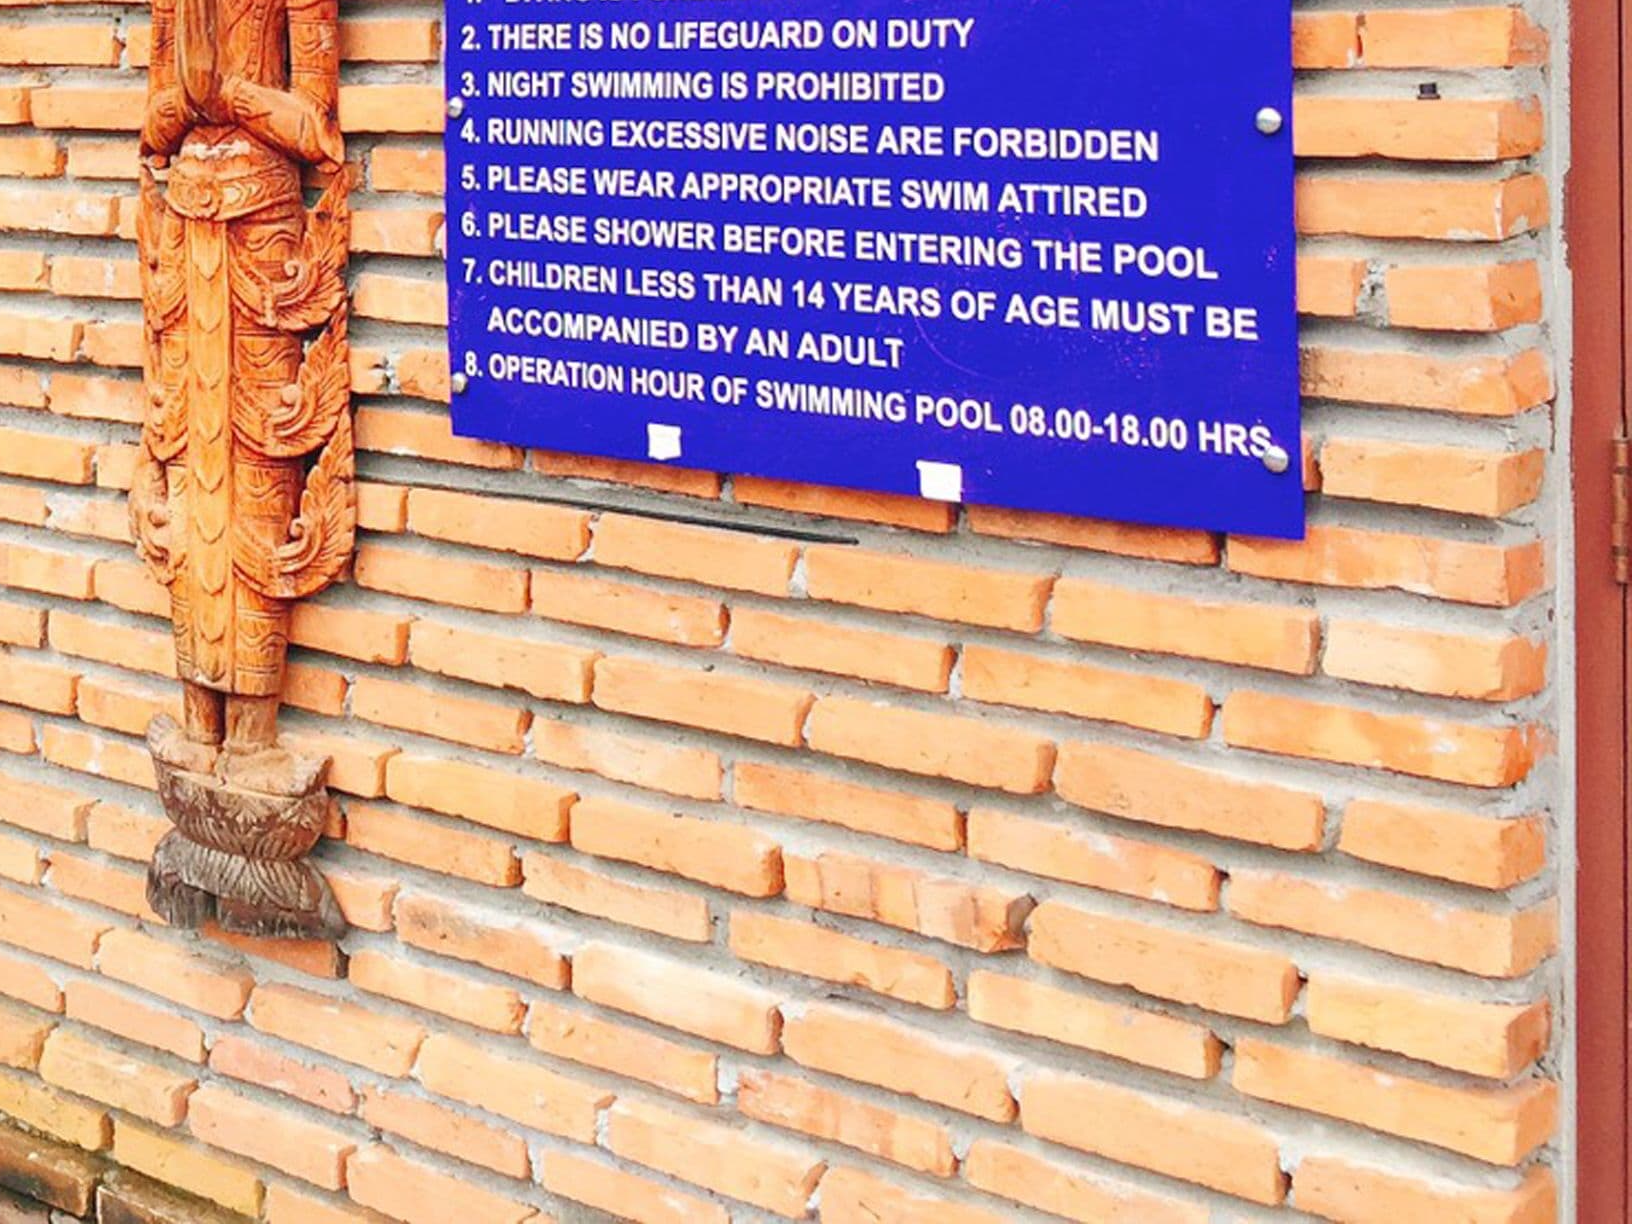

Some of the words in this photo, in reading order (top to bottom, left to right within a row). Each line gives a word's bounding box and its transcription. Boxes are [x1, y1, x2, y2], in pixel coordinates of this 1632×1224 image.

[460, 24, 482, 51] 2.
[487, 23, 572, 50] THERE
[579, 22, 604, 50] IS
[610, 21, 651, 50] NO
[657, 19, 824, 50] LIFEGUARD
[831, 19, 878, 49] ON
[887, 17, 975, 49] DUTY
[460, 71, 482, 97] 3.
[487, 70, 565, 98] NIGHT
[570, 71, 714, 100] SWIMMING
[721, 71, 749, 100] IS
[756, 71, 945, 102] PROHIBITED
[460, 117, 482, 144] 4.
[487, 117, 604, 147] RUNNING
[611, 119, 767, 151] EXCESSIVE
[775, 123, 869, 154] NOISE
[875, 125, 944, 156] ARE
[953, 127, 1159, 162] FORBIDDEN
[461, 164, 482, 191] 5.
[487, 165, 587, 195] PLEASE
[592, 168, 676, 199] WEAR
[680, 171, 892, 208] APPROPRIATE
[900, 179, 989, 212] SWIM
[997, 182, 1148, 218] ATTIRED
[461, 211, 482, 237] 6.
[488, 212, 587, 244] PLEASE
[593, 217, 716, 251] SHOWER
[723, 223, 846, 259] BEFORE
[855, 230, 1023, 269] ENTERING
[1031, 239, 1103, 273] THE
[1113, 243, 1219, 280] POOL
[462, 257, 483, 284] 7.
[488, 259, 618, 295] CHILDREN
[625, 268, 696, 300] LESS
[702, 273, 783, 307] THAN
[791, 279, 825, 310] 14
[831, 281, 942, 318] YEARS
[950, 289, 997, 321] OF
[1004, 293, 1081, 329] AGE
[1091, 298, 1195, 336] MUST
[1205, 305, 1259, 341] BE
[487, 306, 689, 349] ACCOMPANIED
[697, 323, 739, 353] BY
[744, 327, 789, 359] AN
[796, 331, 904, 369] ADULT
[464, 350, 484, 377] 8.
[488, 352, 624, 393] OPERATION
[630, 367, 706, 402] HOUR
[711, 375, 749, 405] OF
[755, 379, 907, 423] SWIMMING
[915, 394, 1003, 433] POOL
[1009, 403, 1188, 451] 08.00-18.00
